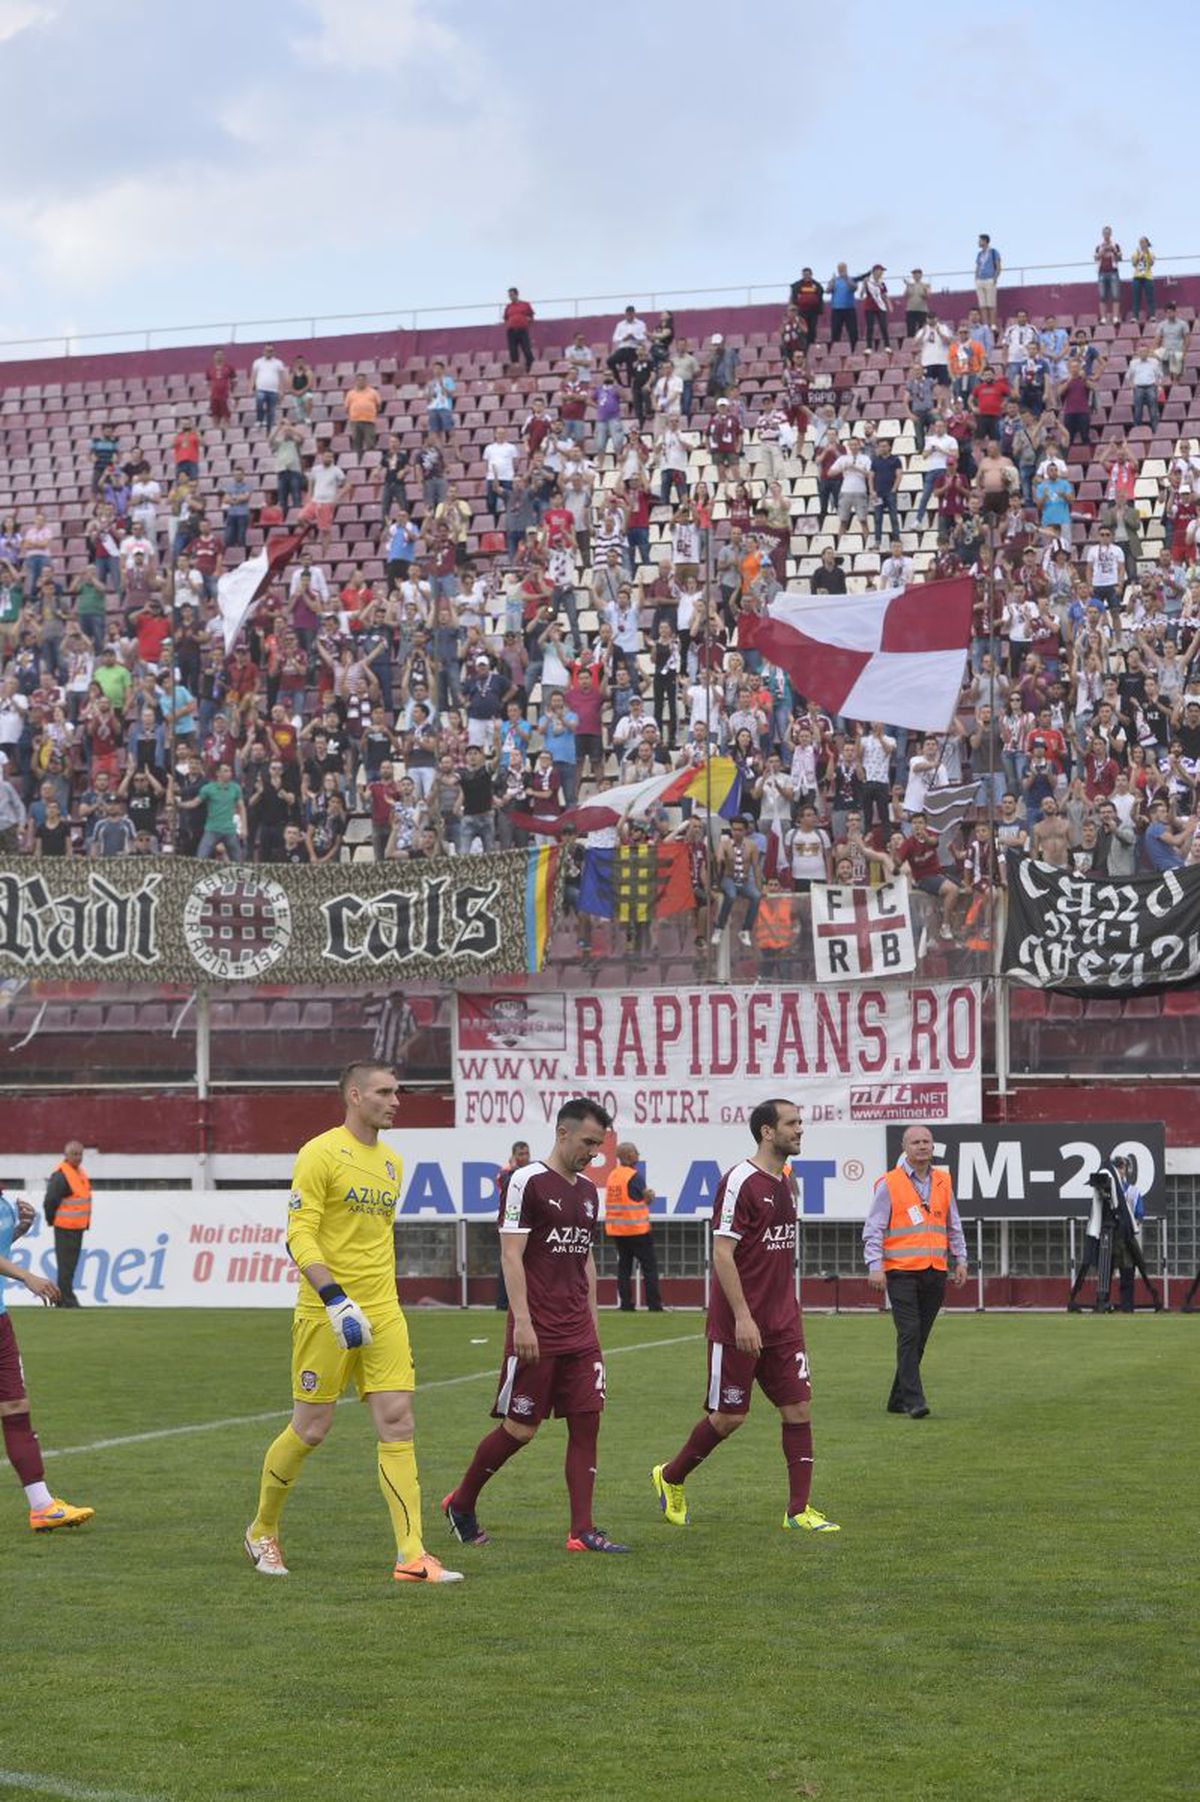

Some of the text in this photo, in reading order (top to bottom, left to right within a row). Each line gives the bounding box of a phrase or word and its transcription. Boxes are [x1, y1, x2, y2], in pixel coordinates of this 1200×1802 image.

[465, 1090, 525, 1124] FOTO
[634, 1090, 709, 1124] STIRI
[851, 1106, 945, 1119] www.mitnet.ro
[189, 1223, 285, 1244] Noi chiar
